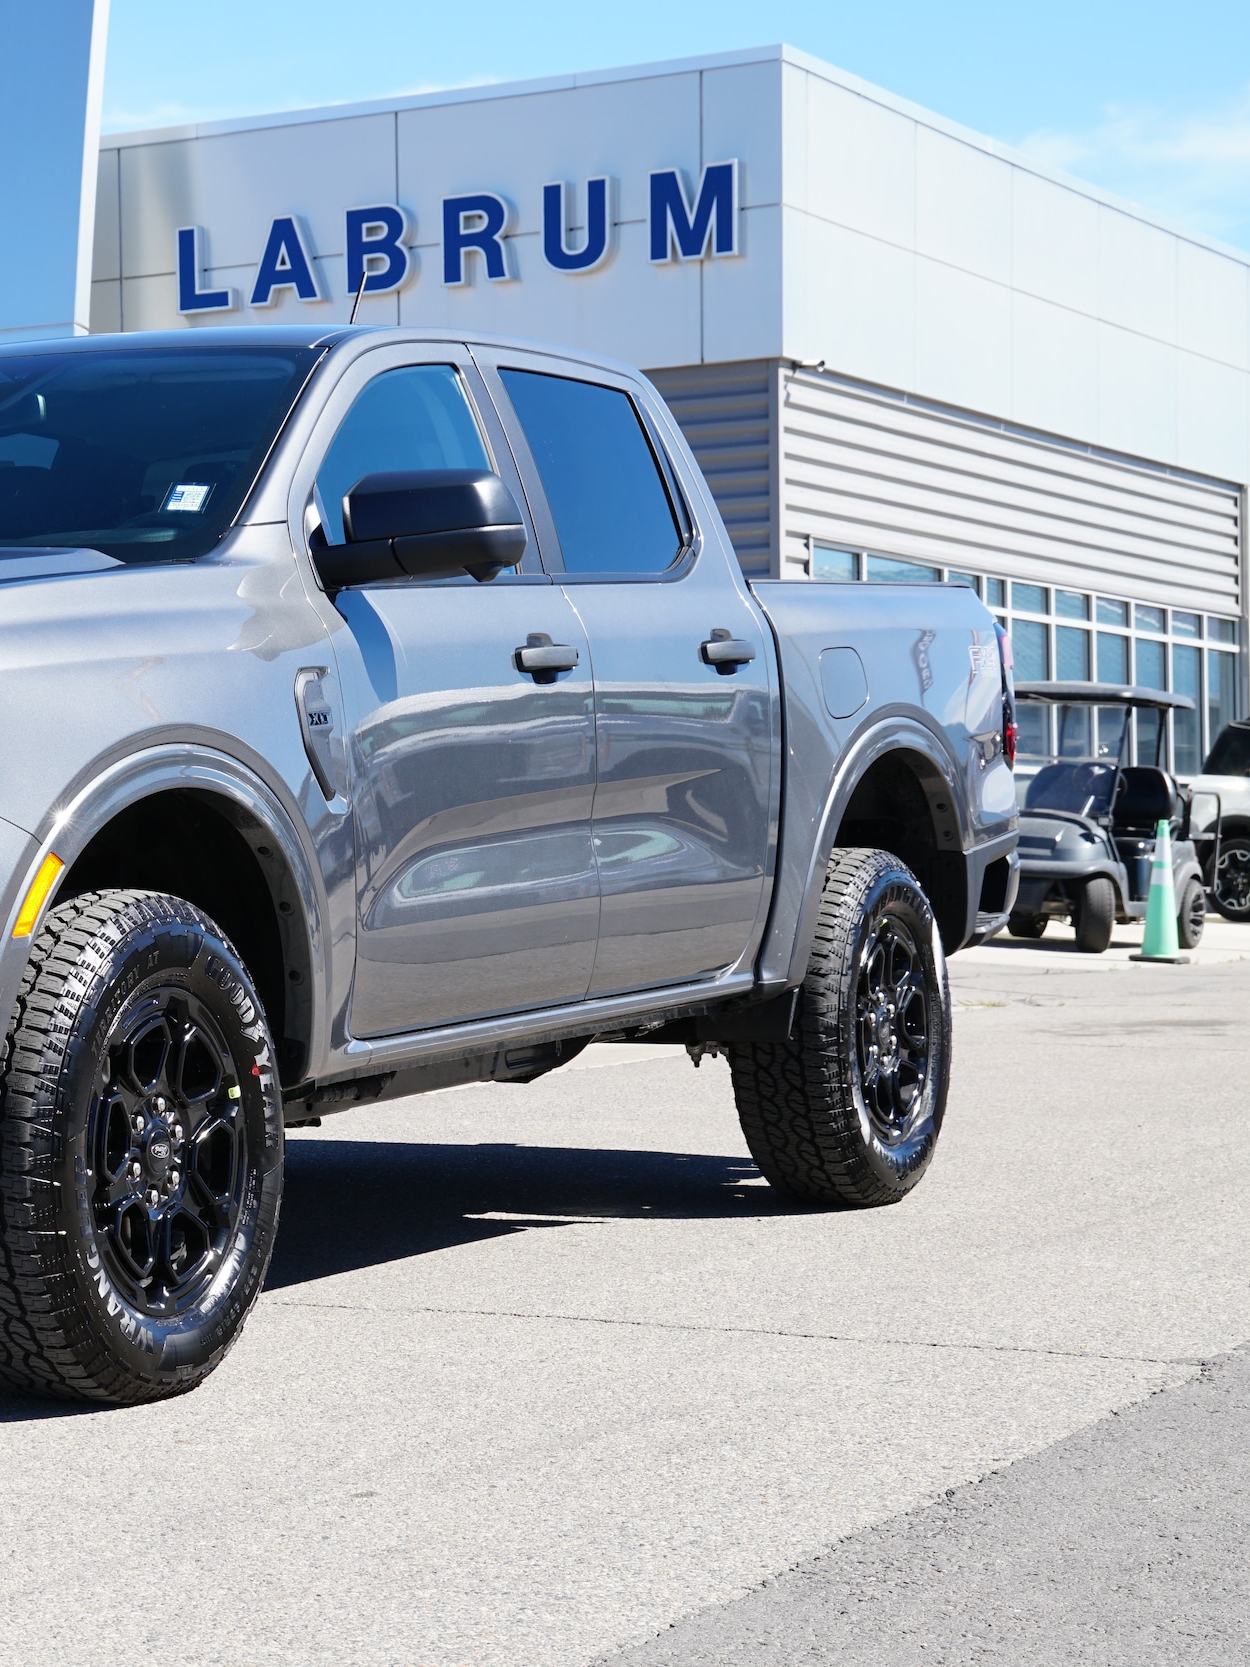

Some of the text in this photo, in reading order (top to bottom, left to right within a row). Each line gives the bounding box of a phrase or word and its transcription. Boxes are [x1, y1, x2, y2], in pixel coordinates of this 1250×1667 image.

[176, 158, 740, 316] LABRUM
[308, 711, 331, 727] XLT
[968, 645, 998, 674] FX4
[91, 950, 160, 1057] TERRITORY AT
[204, 953, 280, 1150] GOODYEAR
[73, 1155, 155, 1356] WRANGLER
